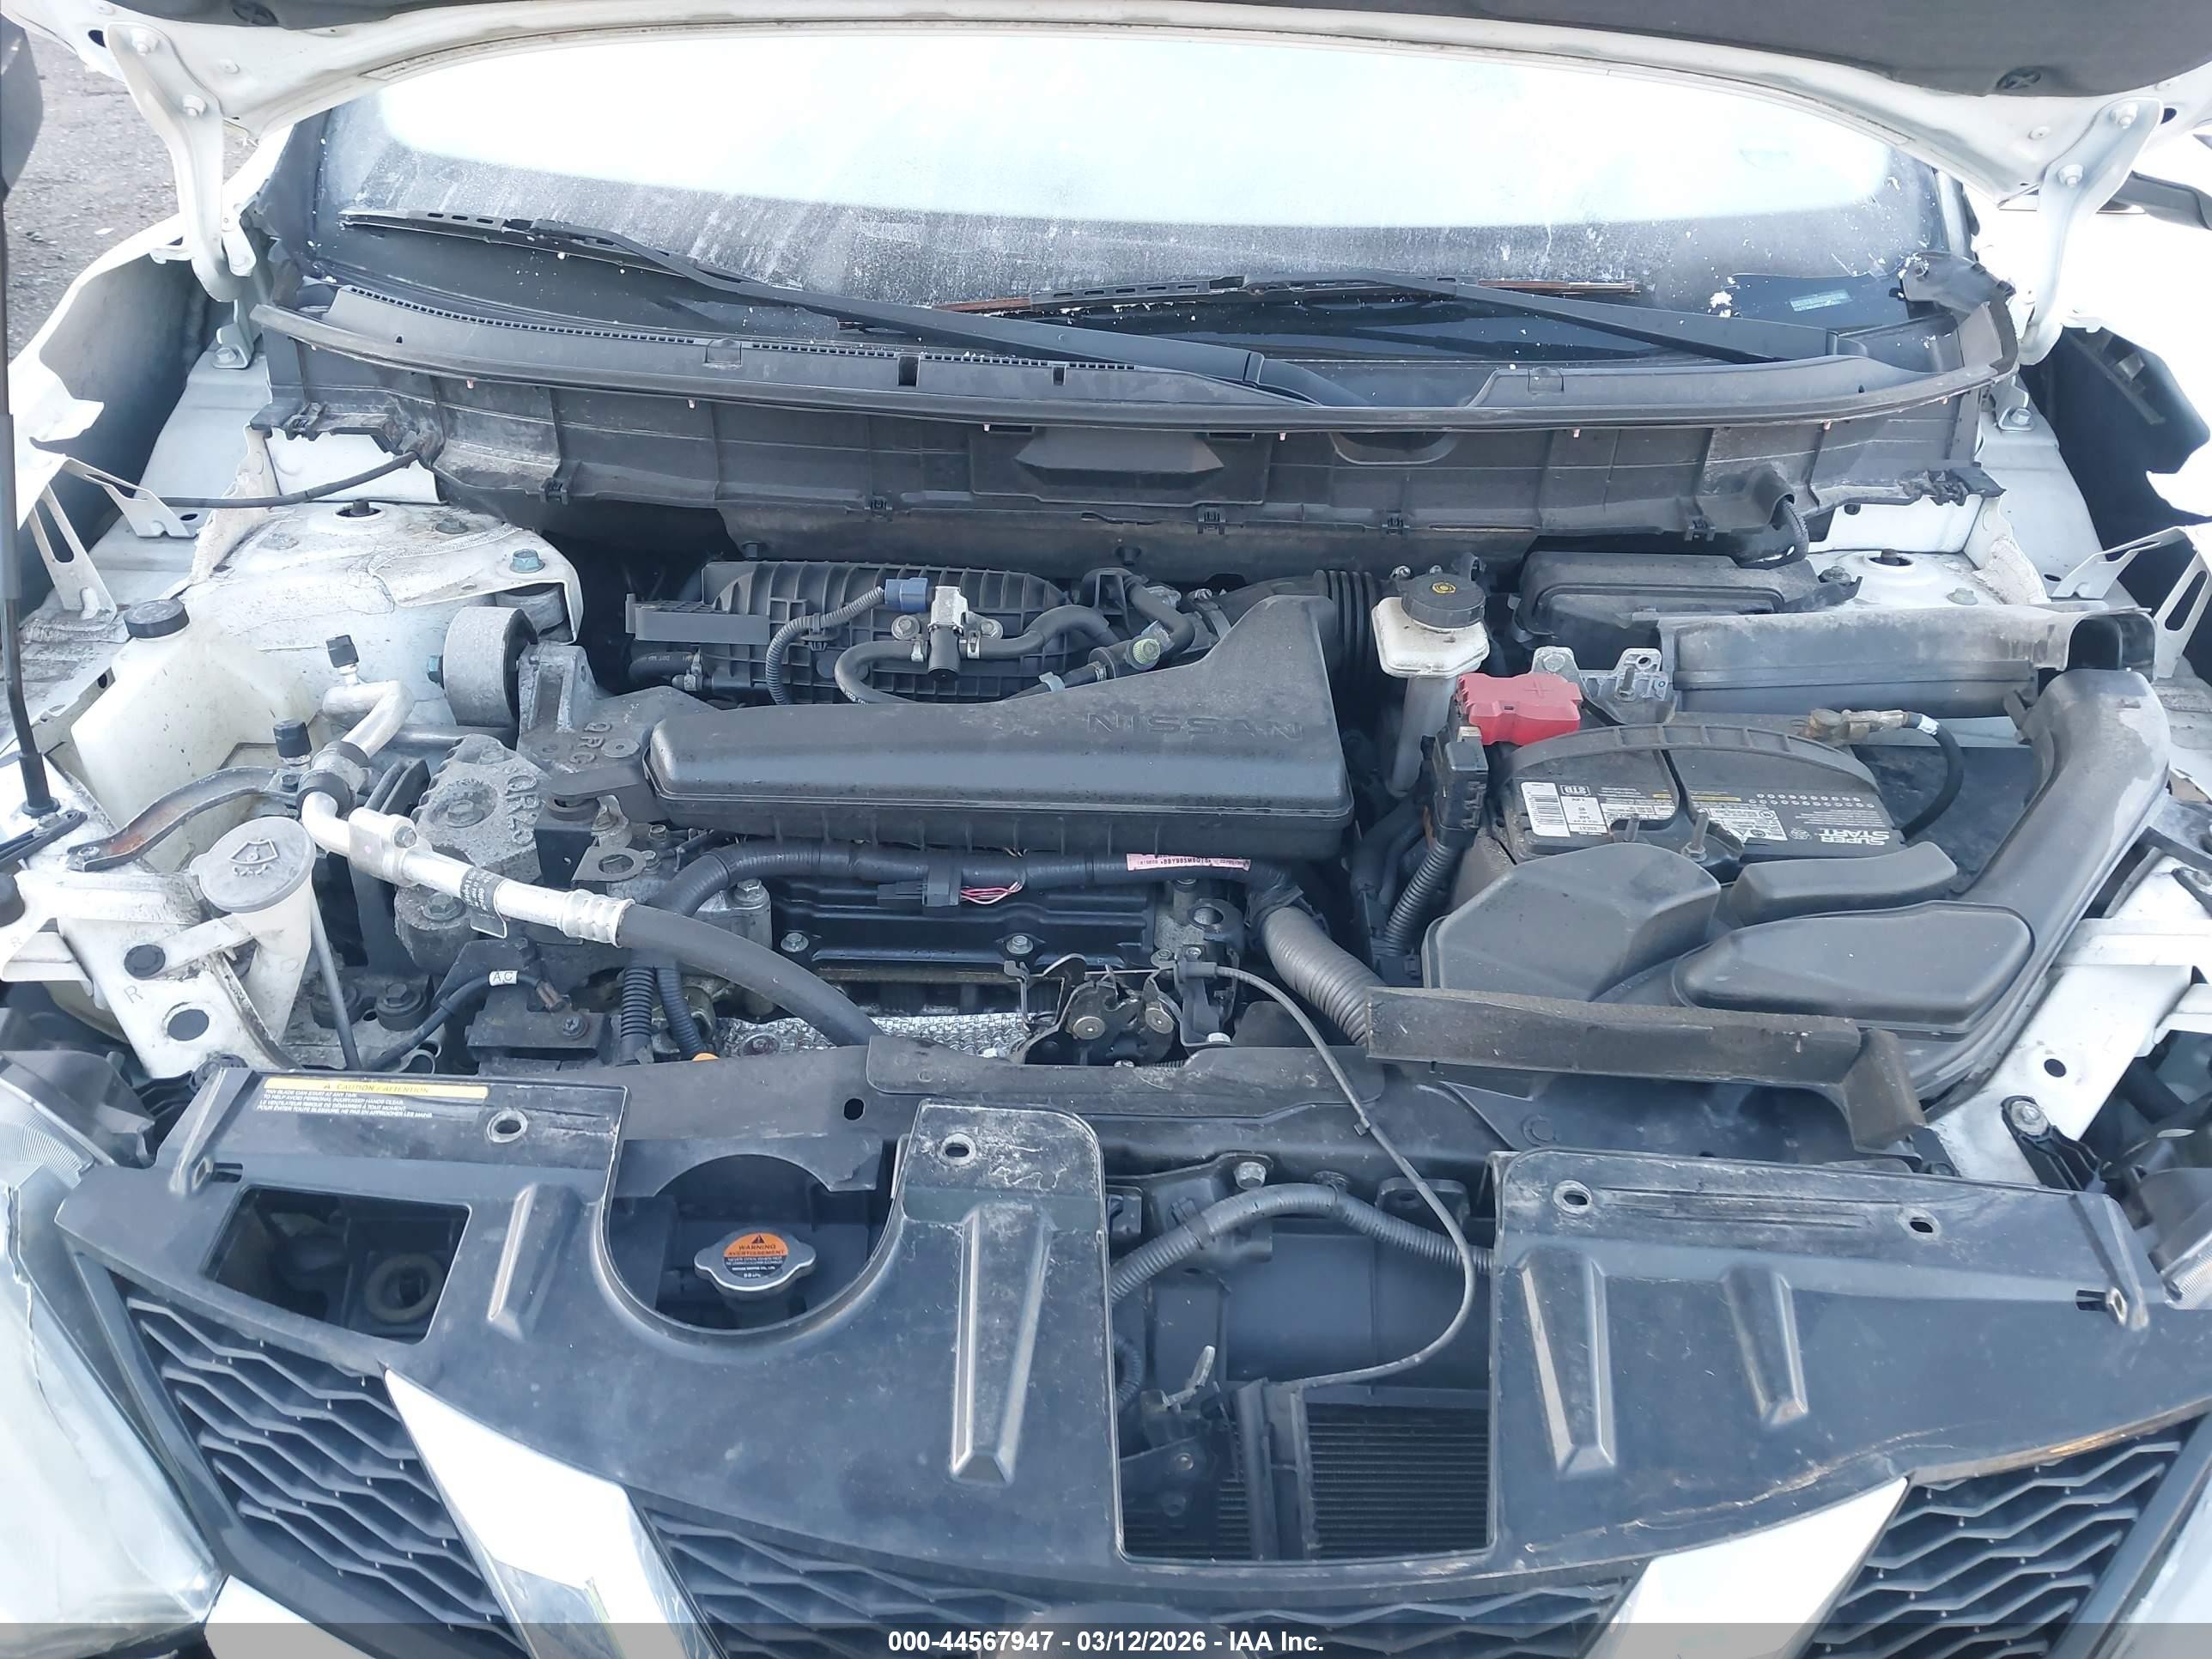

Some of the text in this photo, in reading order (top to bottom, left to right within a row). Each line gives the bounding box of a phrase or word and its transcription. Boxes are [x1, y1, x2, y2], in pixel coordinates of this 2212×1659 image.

[1086, 713, 1304, 741] NISSAN
[1819, 828, 1890, 840] START
[1820, 836, 1886, 846] SUPER
